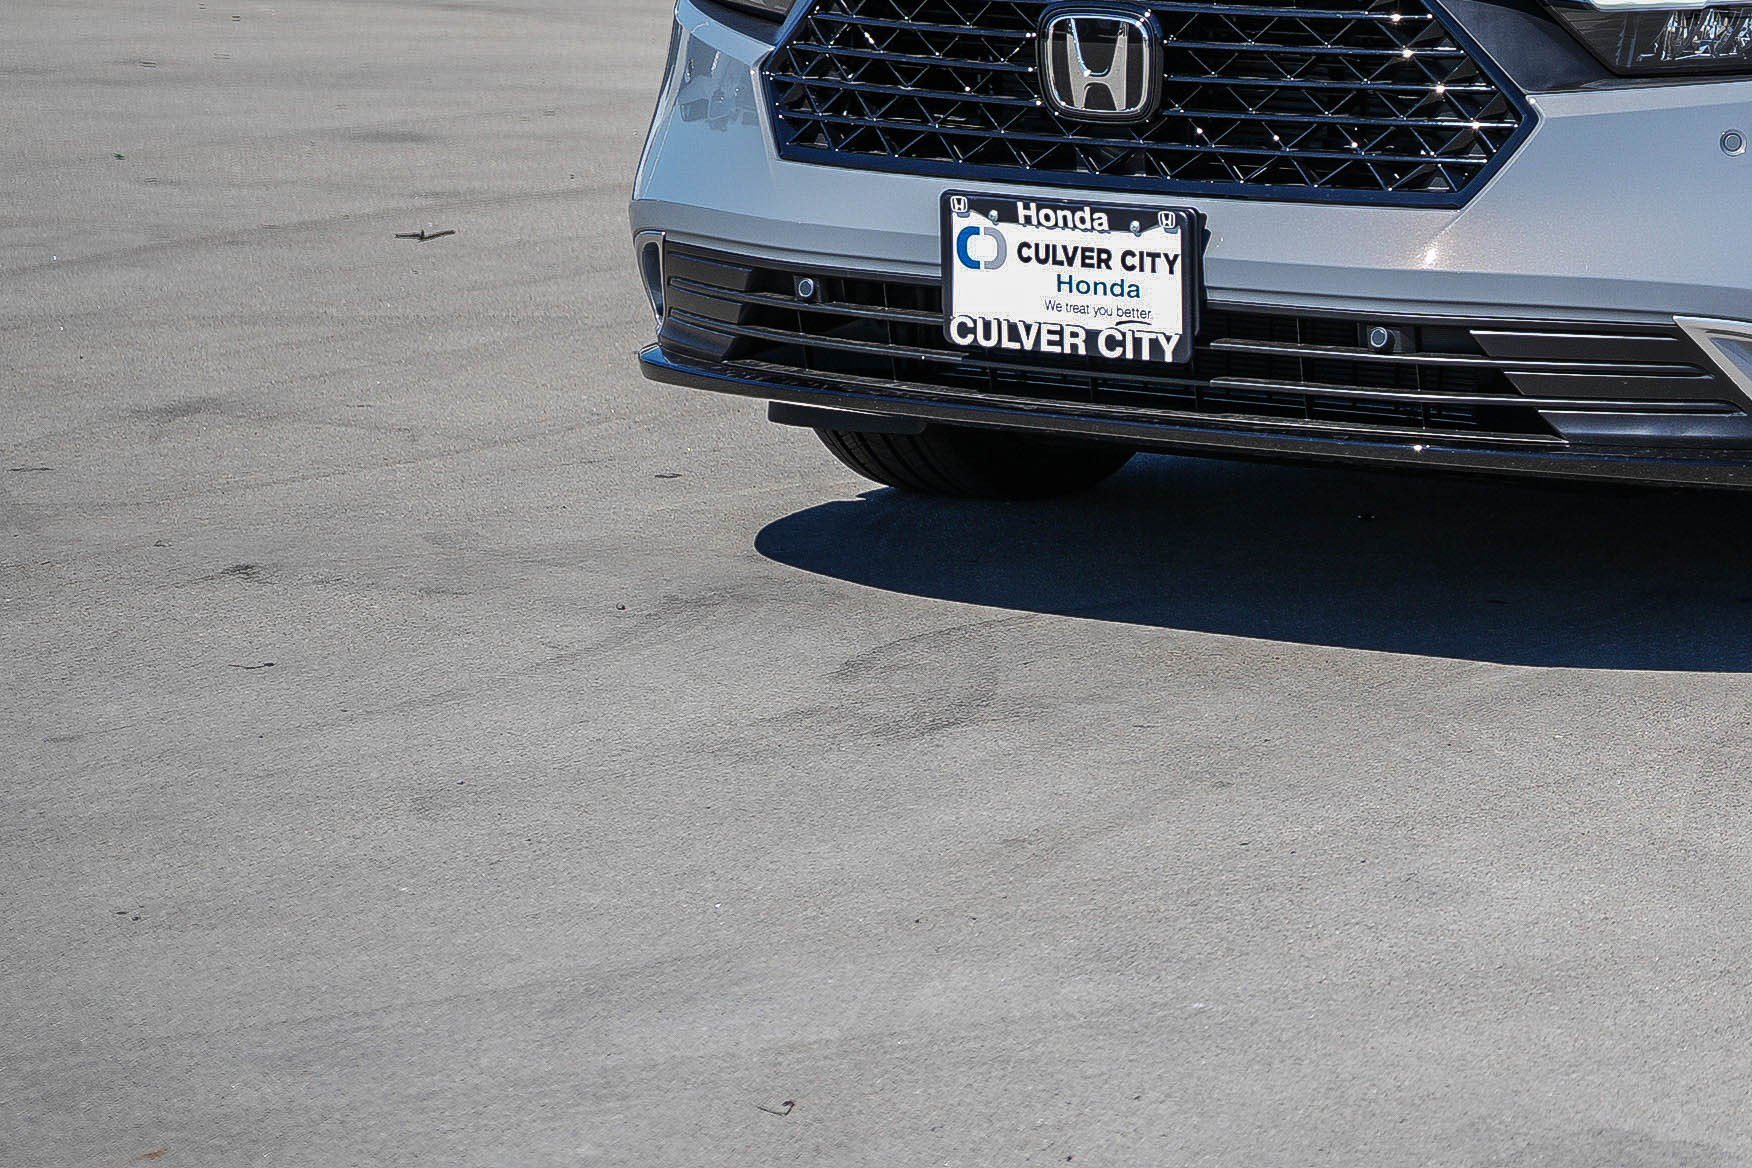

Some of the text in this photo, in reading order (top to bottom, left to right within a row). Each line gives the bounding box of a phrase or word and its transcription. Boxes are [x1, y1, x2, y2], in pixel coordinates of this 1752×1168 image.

[1016, 202, 1110, 231] Honda
[1017, 241, 1180, 274] CULVER CITY
[1056, 274, 1141, 298] Honda
[1045, 299, 1062, 312] We
[1066, 303, 1090, 314] treat
[1093, 306, 1112, 318] you
[950, 315, 1183, 363] CULVER CITY
